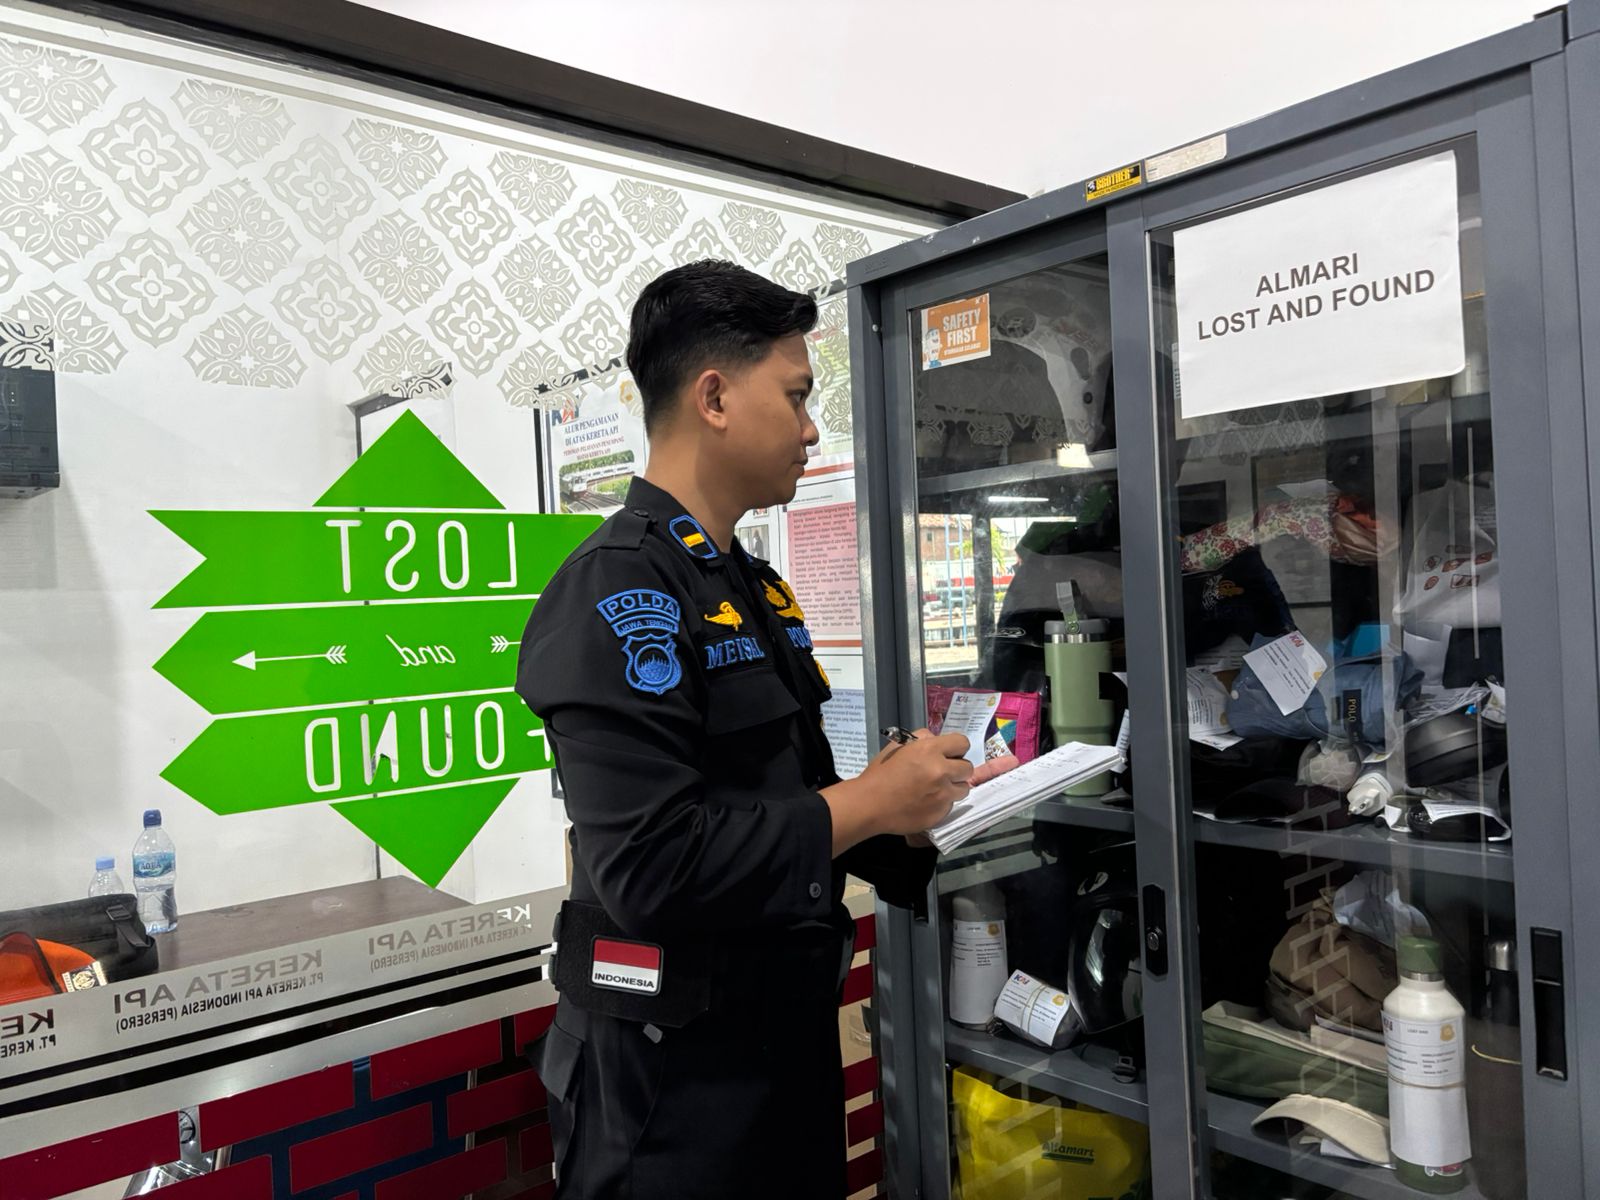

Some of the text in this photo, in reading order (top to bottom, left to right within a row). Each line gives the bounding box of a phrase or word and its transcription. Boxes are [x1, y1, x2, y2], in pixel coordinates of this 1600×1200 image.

[1256, 252, 1359, 297] ALMARI
[1198, 269, 1435, 340] LOST AND FOUND
[943, 307, 981, 332] SAFETY
[586, 428, 609, 441] KERETA
[606, 593, 676, 616] POLDA
[620, 621, 643, 631] JAWA
[1348, 697, 1357, 722] POLO
[594, 973, 655, 988] INDONESIA
[1042, 1142, 1096, 1157] Alfamart
